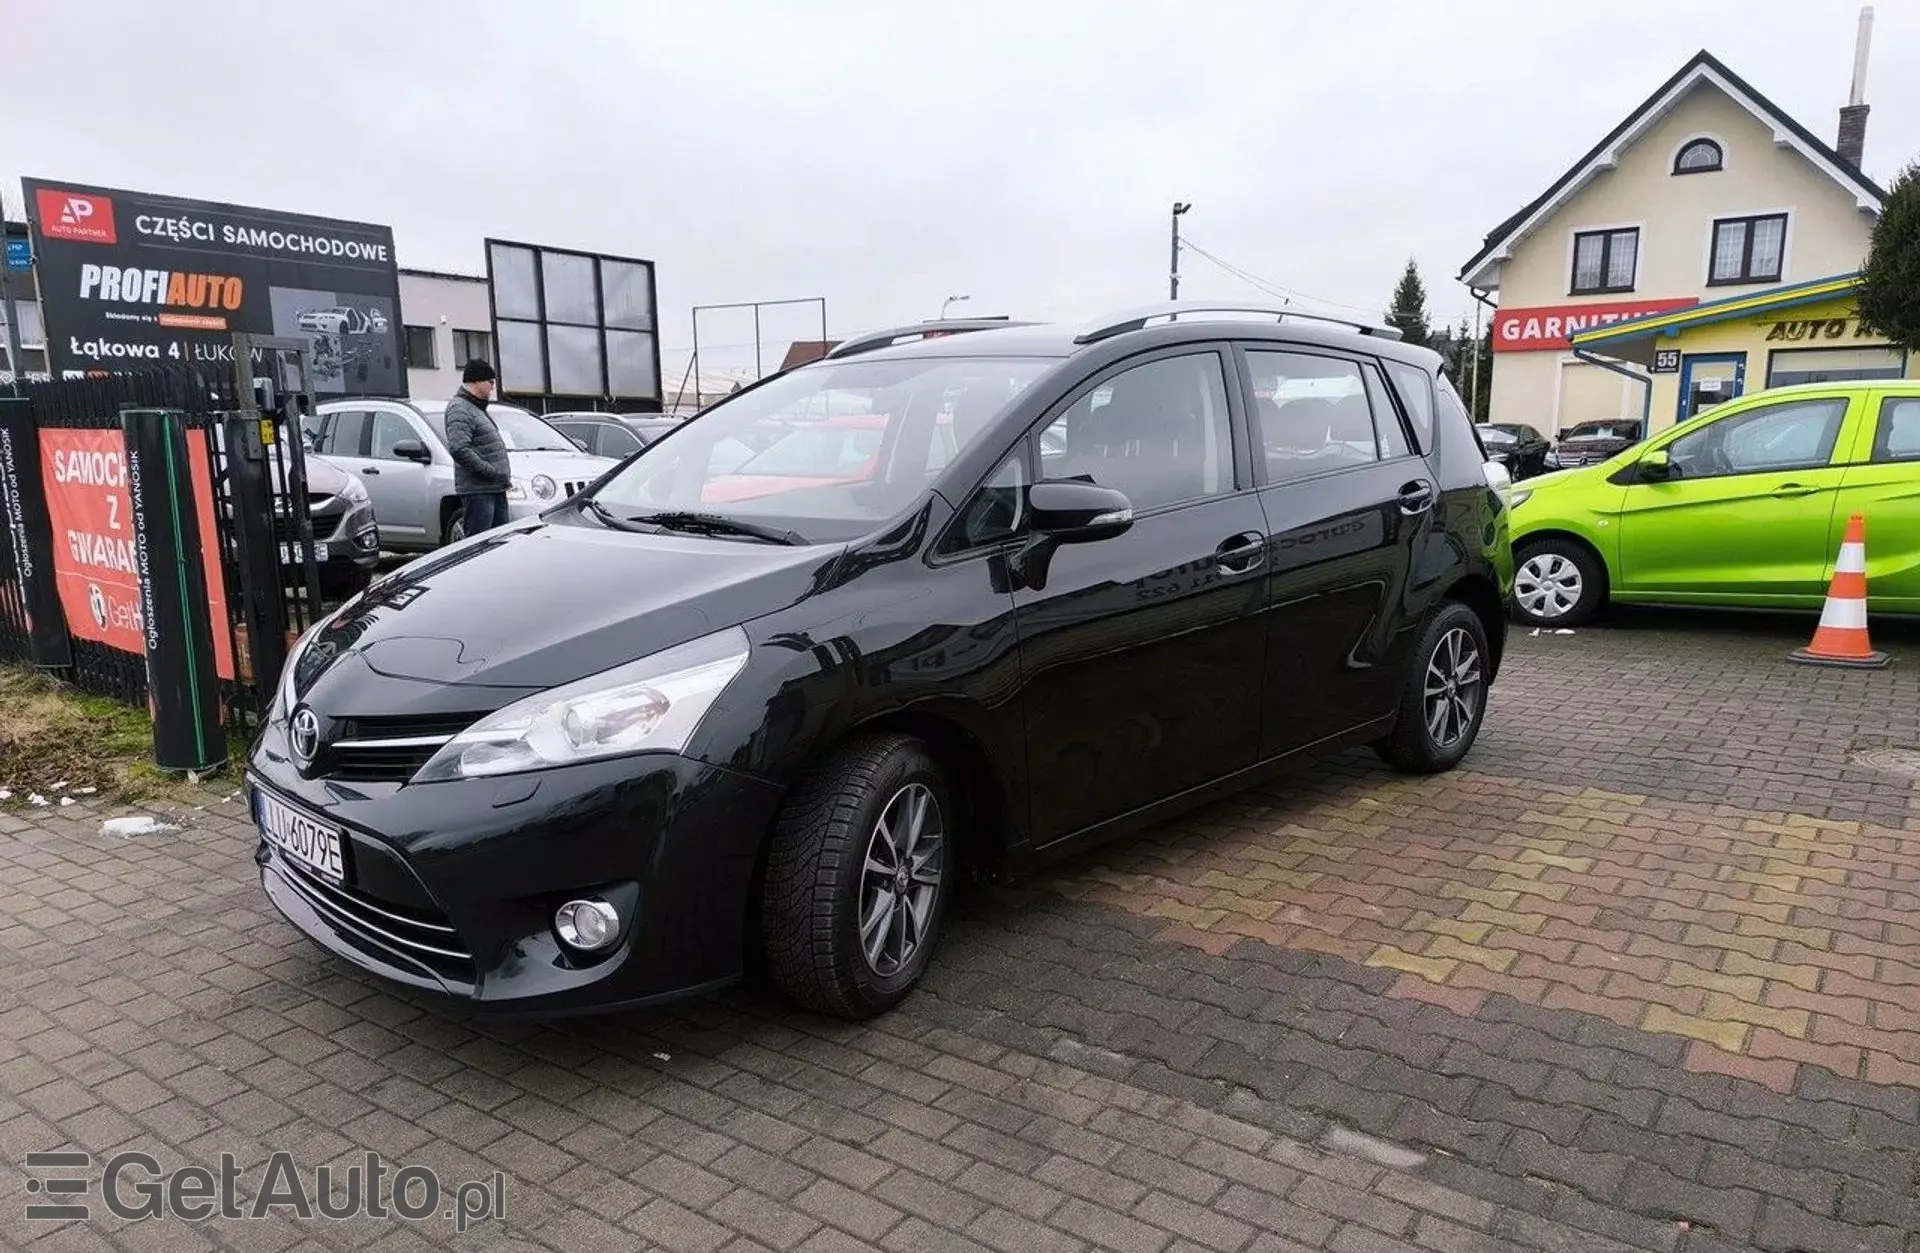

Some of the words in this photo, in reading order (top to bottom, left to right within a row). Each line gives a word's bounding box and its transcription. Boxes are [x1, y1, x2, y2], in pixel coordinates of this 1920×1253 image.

[51, 224, 72, 234] AUTO
[135, 214, 215, 242] CZĘŚCI
[223, 225, 387, 262] SAMOCHODOWE
[80, 264, 244, 310] PROFIAUTO
[1765, 319, 1847, 342] AUTO
[70, 336, 160, 360] Łąkowa
[168, 341, 181, 360] 4
[1657, 352, 1678, 368] 55
[2, 428, 14, 473] YANOSIK
[7, 474, 17, 488] od
[130, 450, 143, 509] YANOSIK
[11, 490, 23, 521] MOTO
[106, 494, 121, 530] Z
[136, 512, 146, 531] od
[137, 533, 150, 575] MOTO
[290, 816, 343, 874] 6079E
